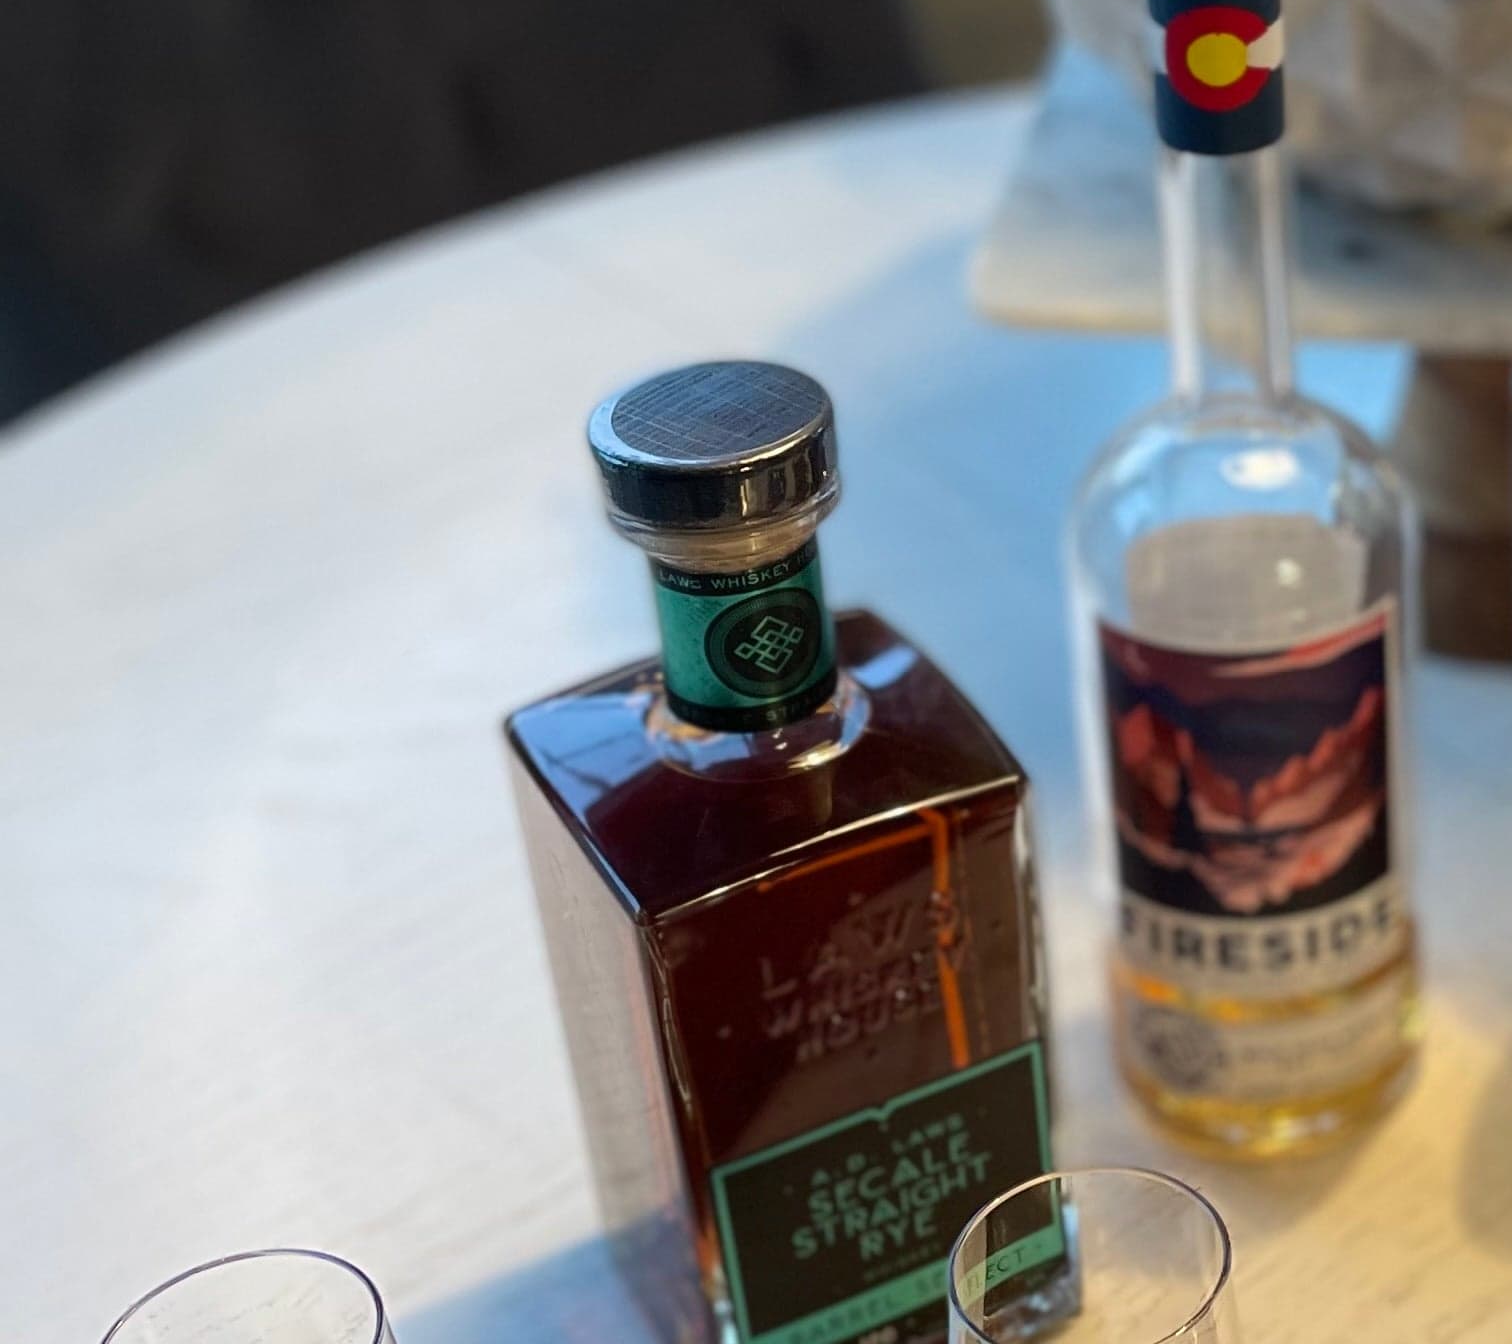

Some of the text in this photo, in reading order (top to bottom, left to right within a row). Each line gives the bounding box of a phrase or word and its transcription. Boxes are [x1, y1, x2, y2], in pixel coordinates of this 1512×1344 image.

[710, 562, 791, 590] WHISKEY
[791, 1152, 993, 1259] STRAIGHT
[807, 1131, 970, 1216] SECALE
[859, 1208, 938, 1260] RYE
